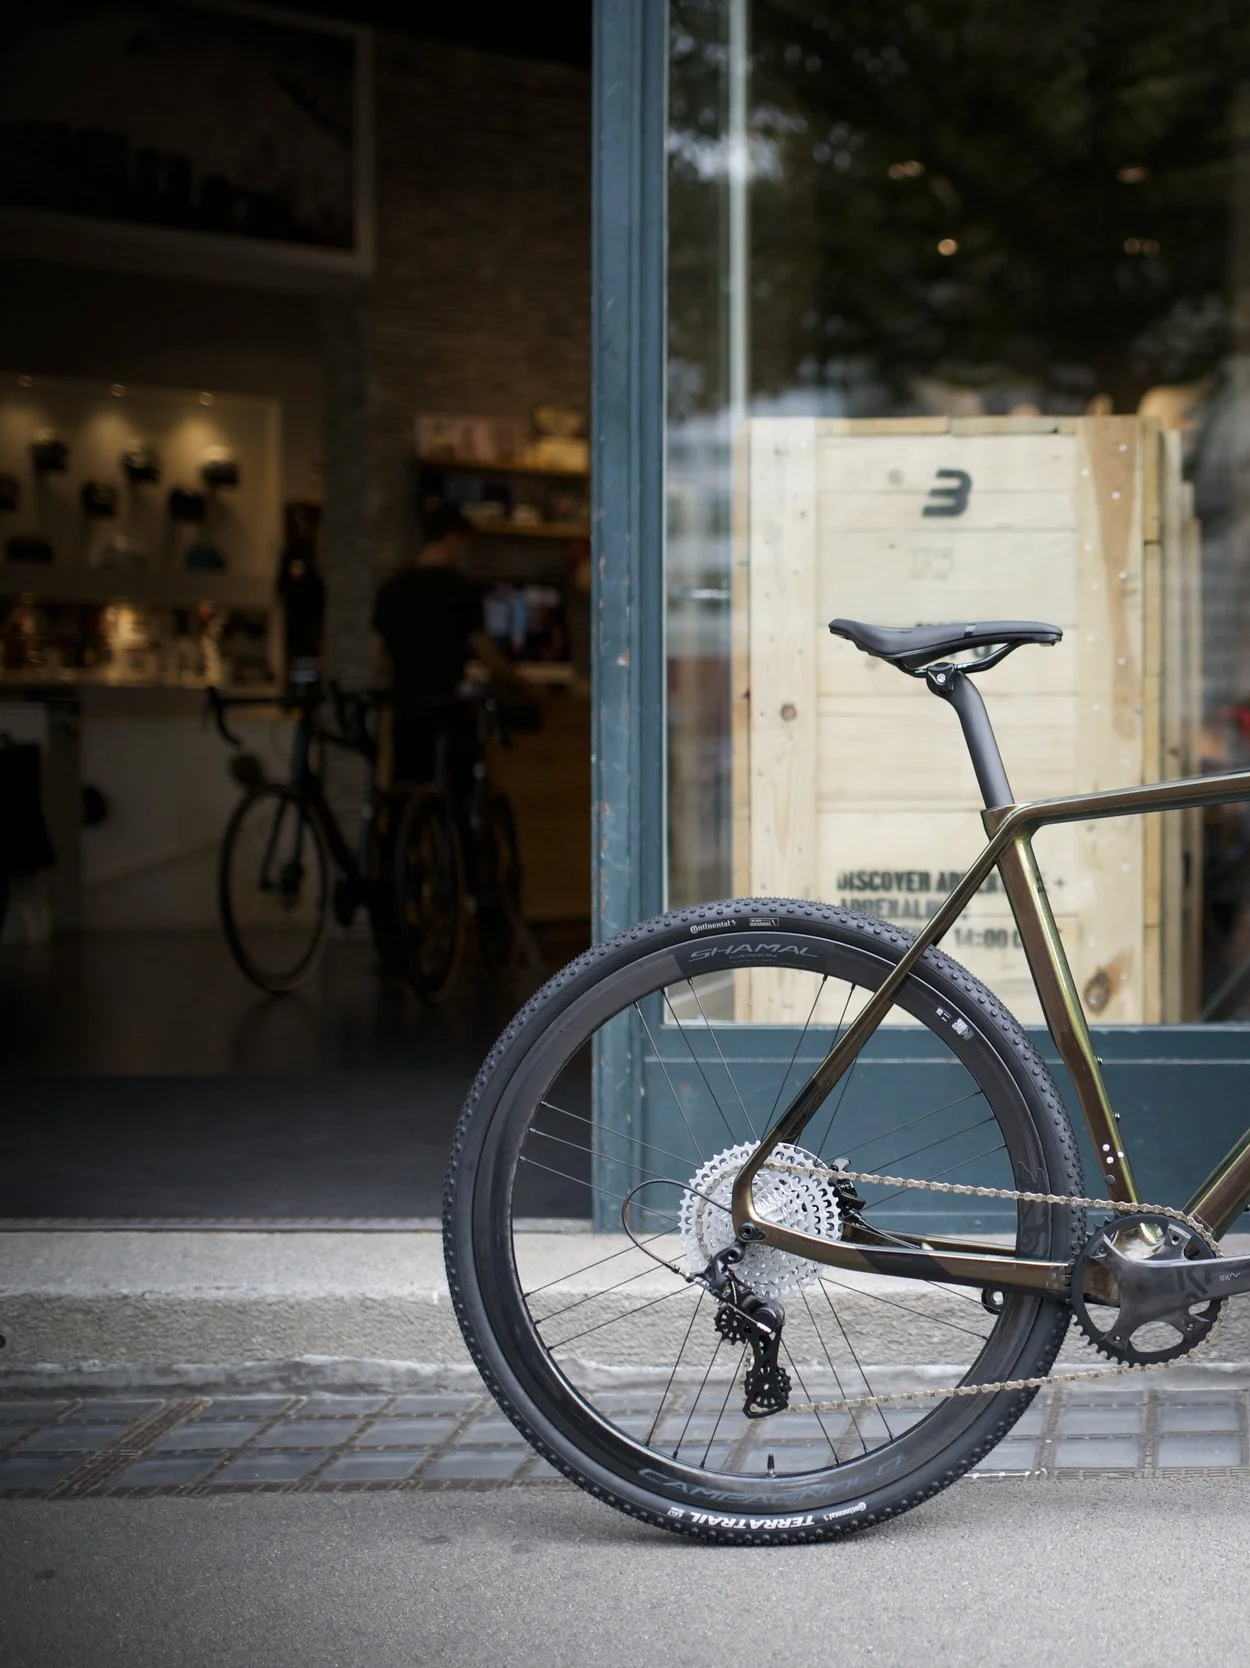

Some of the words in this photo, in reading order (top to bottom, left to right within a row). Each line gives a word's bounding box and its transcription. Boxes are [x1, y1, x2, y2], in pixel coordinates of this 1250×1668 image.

[837, 869, 931, 892] DISCOVER
[689, 919, 731, 934] Continental
[954, 927, 1008, 949] 14:00
[687, 943, 819, 962] SHAMAL
[690, 1511, 747, 1529] TRAIL
[749, 1514, 815, 1530] TERRA
